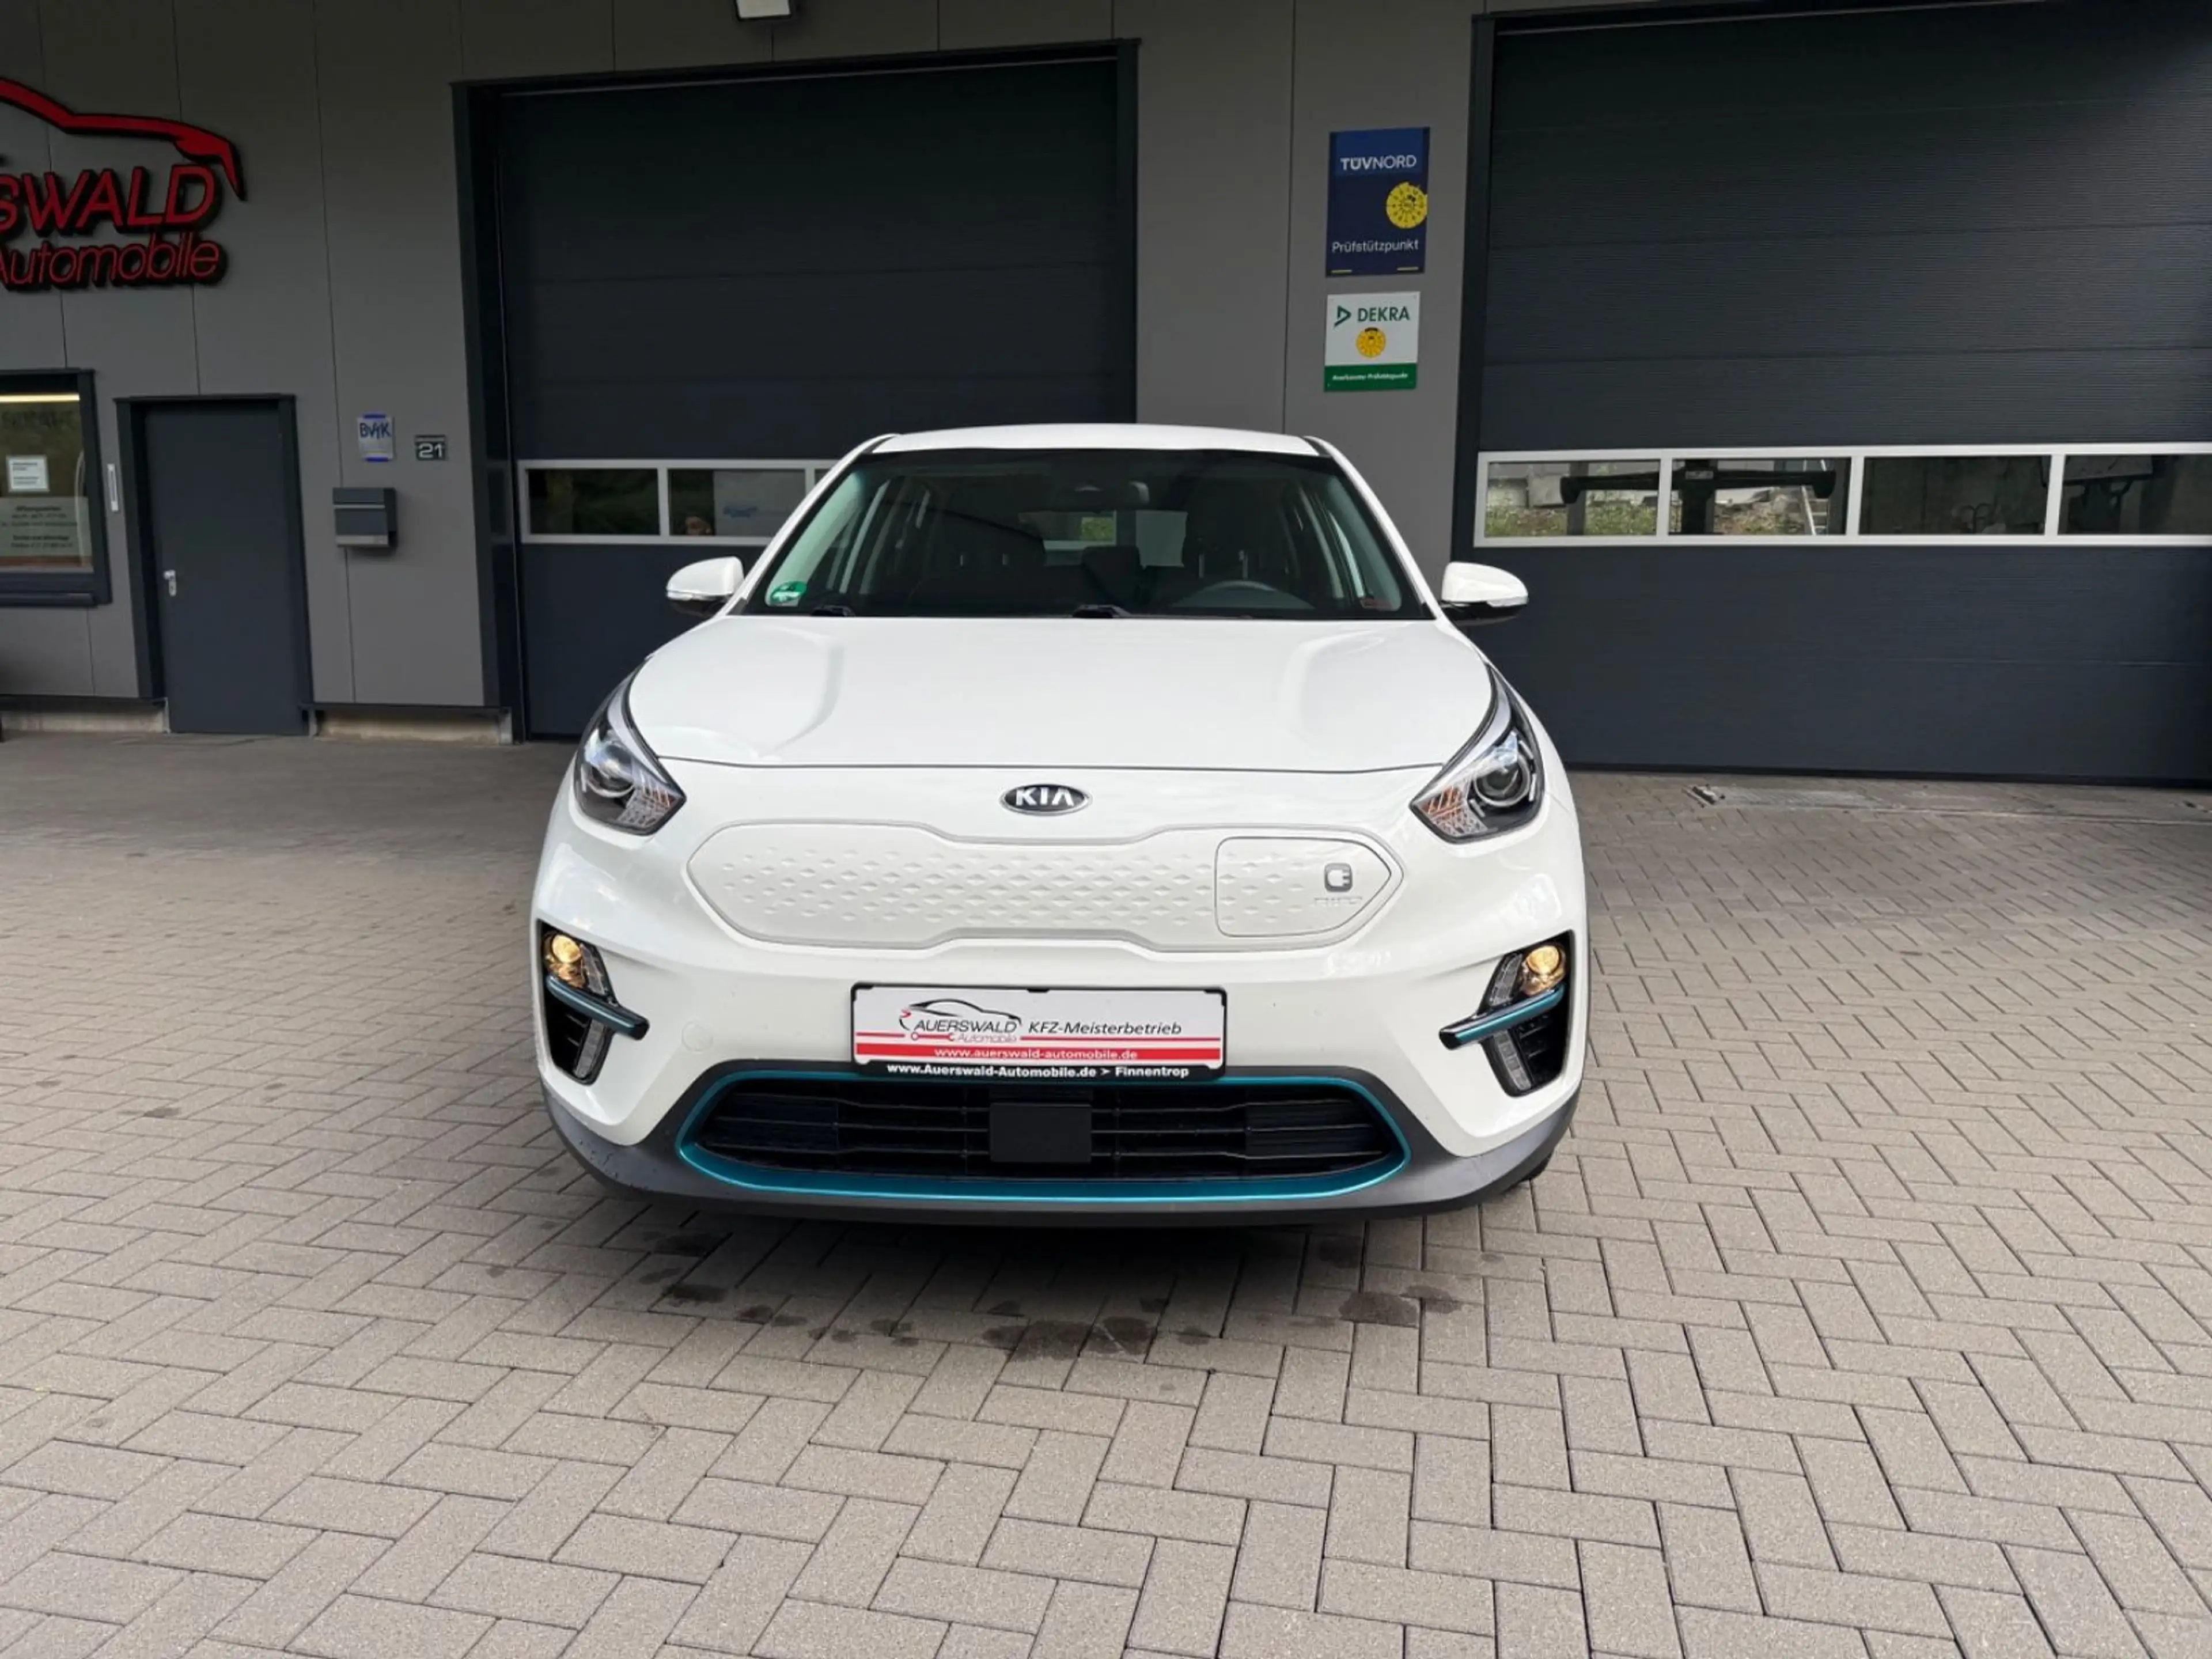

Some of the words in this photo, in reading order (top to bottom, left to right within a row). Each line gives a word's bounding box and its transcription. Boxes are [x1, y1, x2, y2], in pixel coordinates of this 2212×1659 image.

[1332, 239, 1419, 253] Prüfstützpunkt
[1358, 306, 1410, 322] DEKRA
[418, 443, 443, 458] 21
[1016, 787, 1074, 806] KIA
[914, 1020, 1017, 1032] AUERSWALD
[1028, 1021, 1182, 1035] KFZ-Meisterbetrieb
[934, 1048, 1138, 1059] www.auerswald-automobile.de
[887, 1064, 1096, 1077] www.Auerswald-Automobile.de
[1115, 1067, 1190, 1078] Finnentrop
